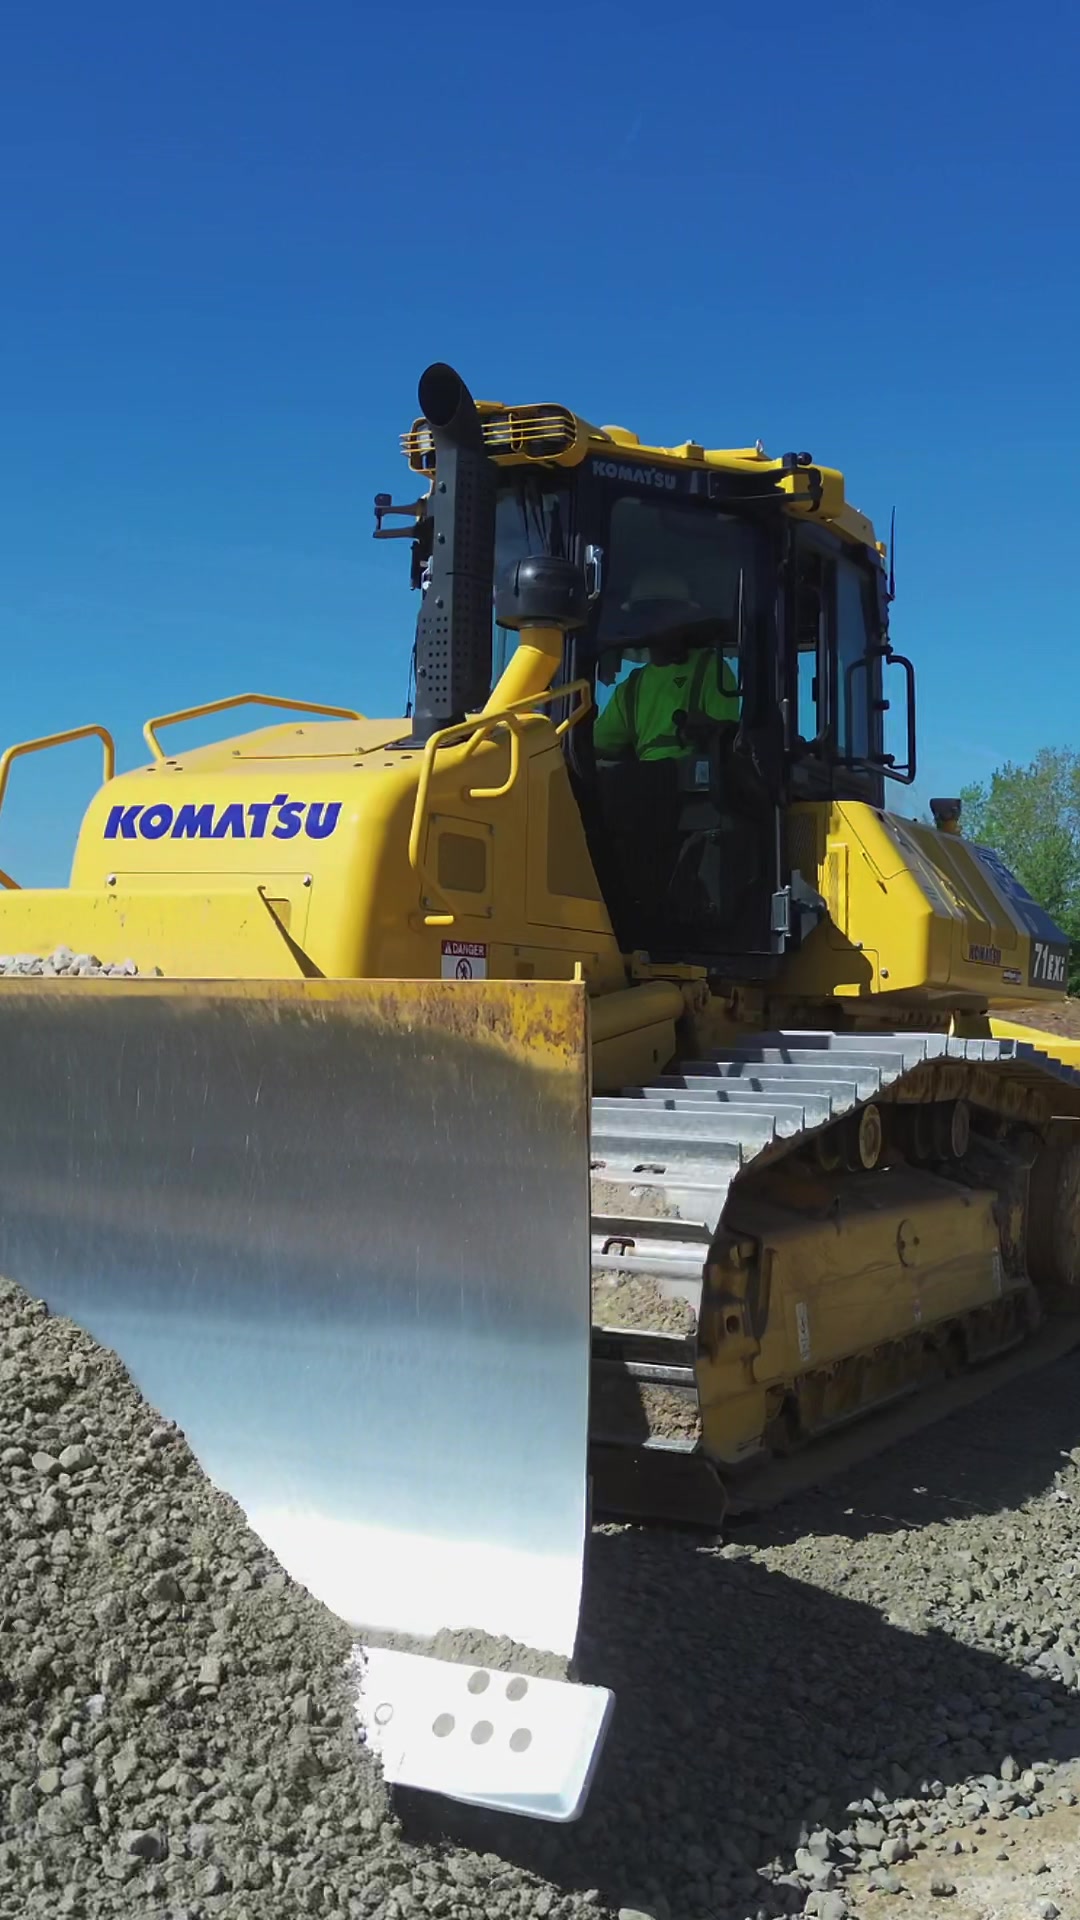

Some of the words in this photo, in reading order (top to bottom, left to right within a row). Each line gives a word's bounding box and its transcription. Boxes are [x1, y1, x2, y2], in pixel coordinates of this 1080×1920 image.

[592, 461, 677, 490] KOMATSU
[103, 793, 343, 840] KOMATSU
[452, 943, 485, 956] DANGER
